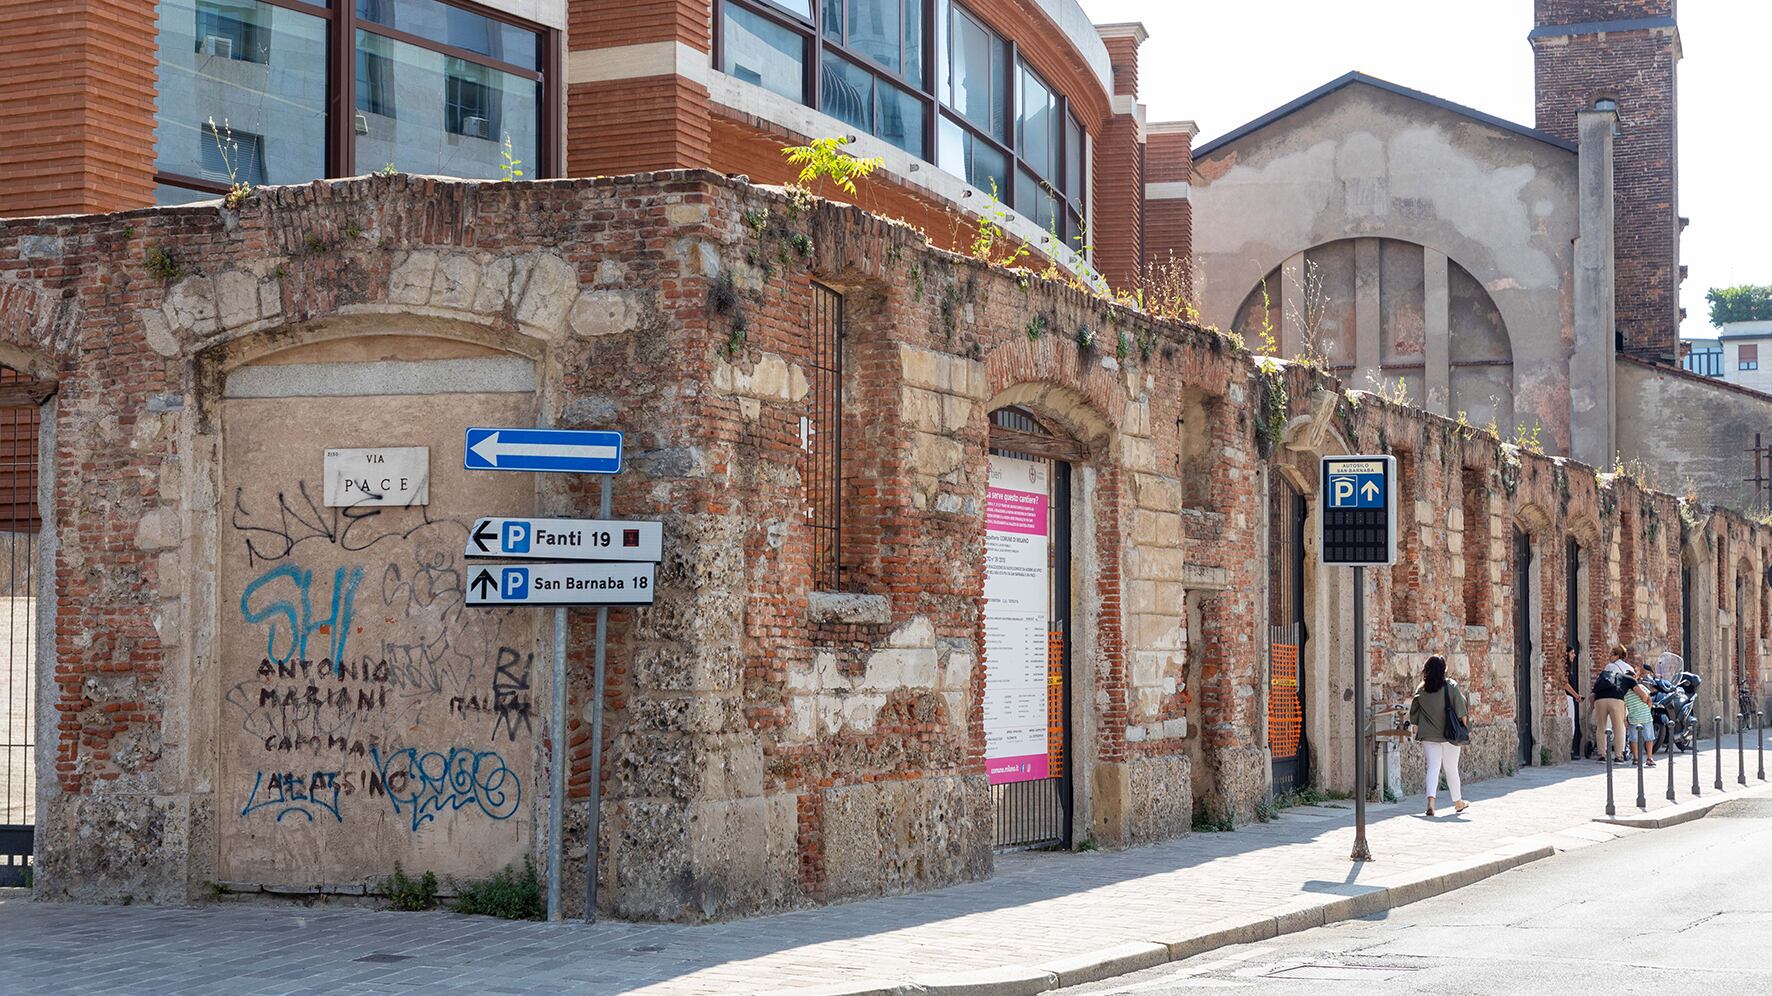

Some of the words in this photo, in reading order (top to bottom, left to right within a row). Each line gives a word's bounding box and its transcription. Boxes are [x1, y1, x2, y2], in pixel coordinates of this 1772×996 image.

[366, 454, 385, 463] VIA
[345, 478, 408, 492] PACE
[1004, 493, 1019, 503] questo
[508, 525, 526, 549] P
[536, 529, 582, 546] Fanti
[592, 531, 611, 547] 19
[507, 572, 524, 596] P
[534, 577, 560, 590] San
[566, 577, 625, 589] Barnaba
[632, 576, 648, 589] 18
[257, 658, 389, 683] ANTONIO
[259, 685, 387, 713] MARIANI
